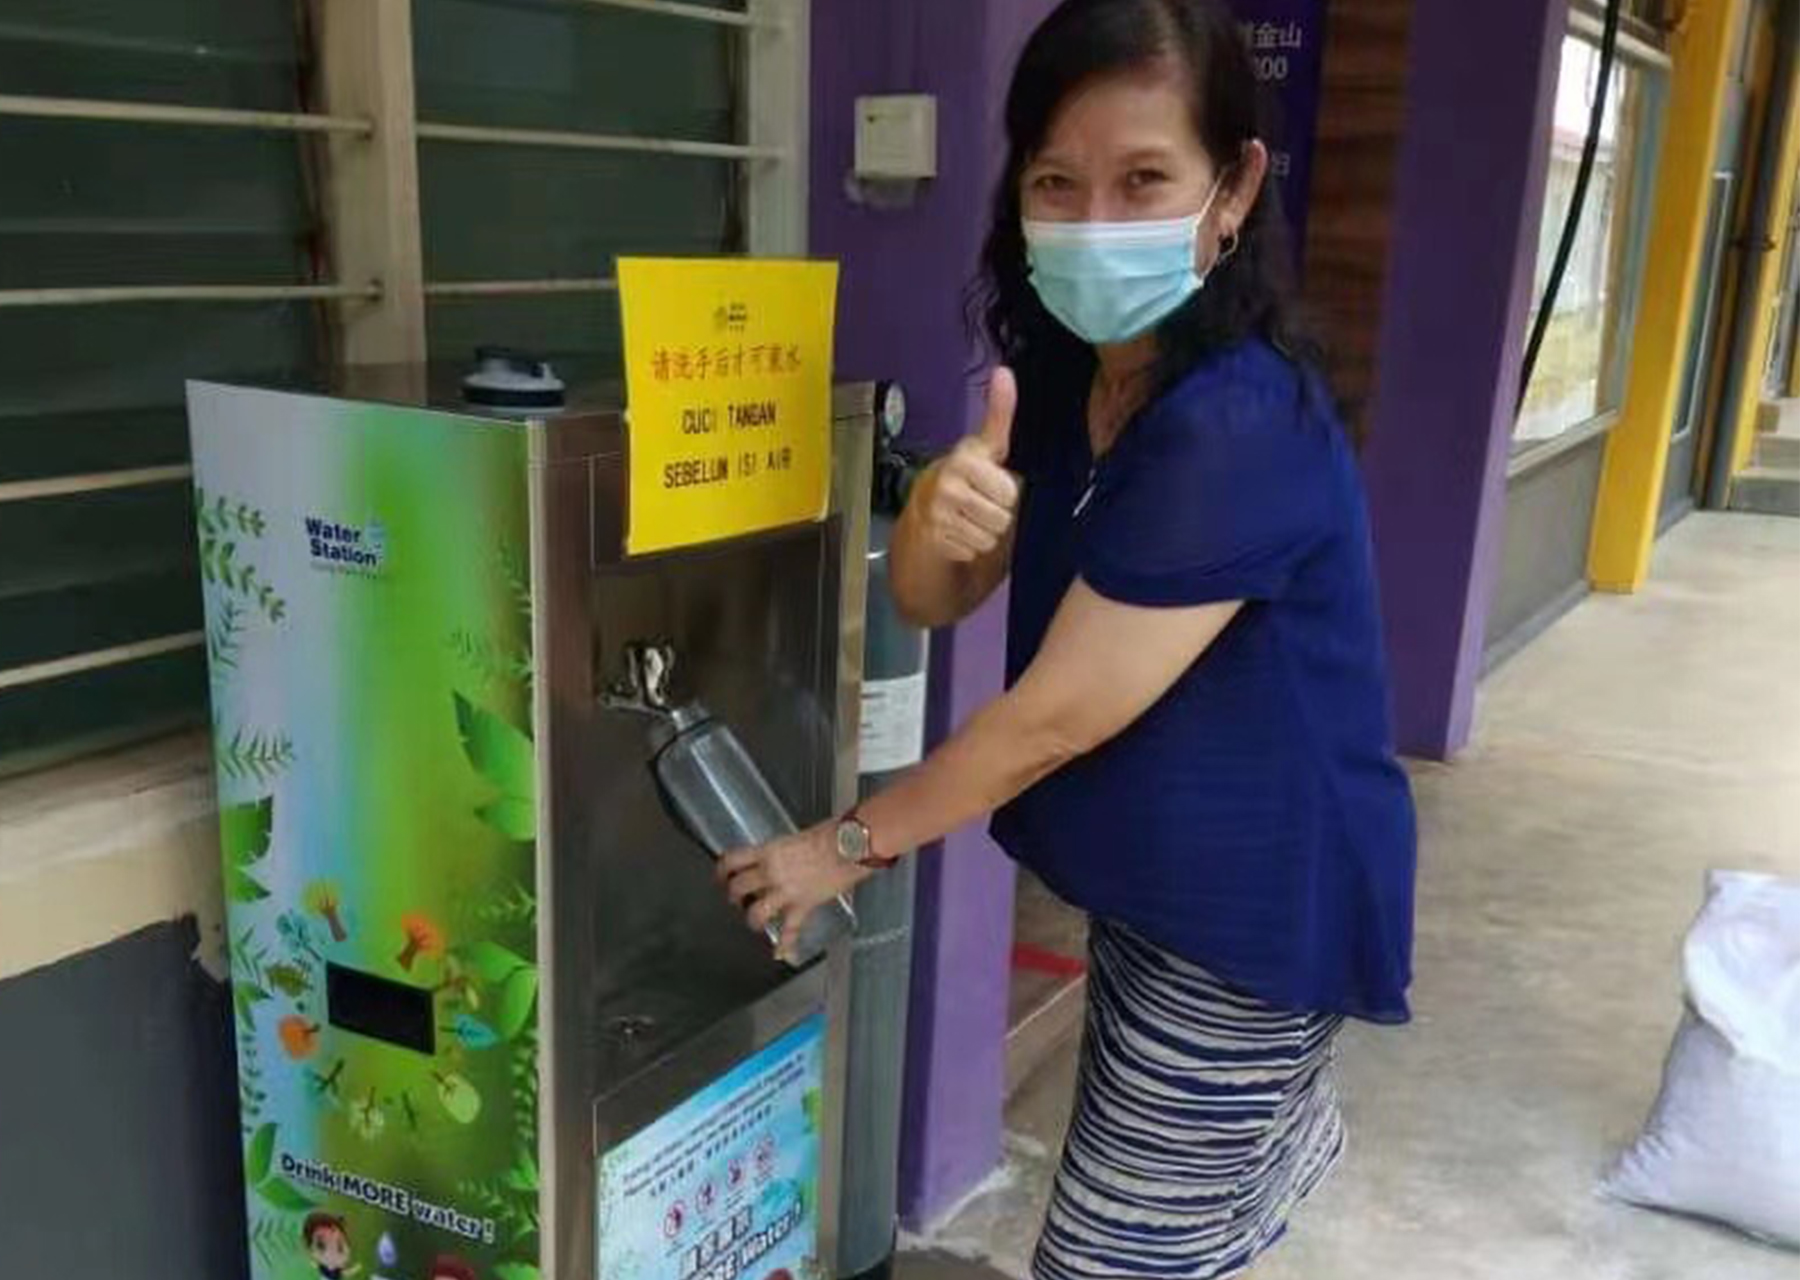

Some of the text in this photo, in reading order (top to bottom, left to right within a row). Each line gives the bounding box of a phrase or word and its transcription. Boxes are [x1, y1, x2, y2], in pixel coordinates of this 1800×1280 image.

[682, 403, 776, 434] CUCI TANGAN
[305, 517, 361, 543] Water
[310, 538, 377, 566] Station
[281, 1154, 337, 1187] Drink
[342, 1176, 409, 1214] MORE
